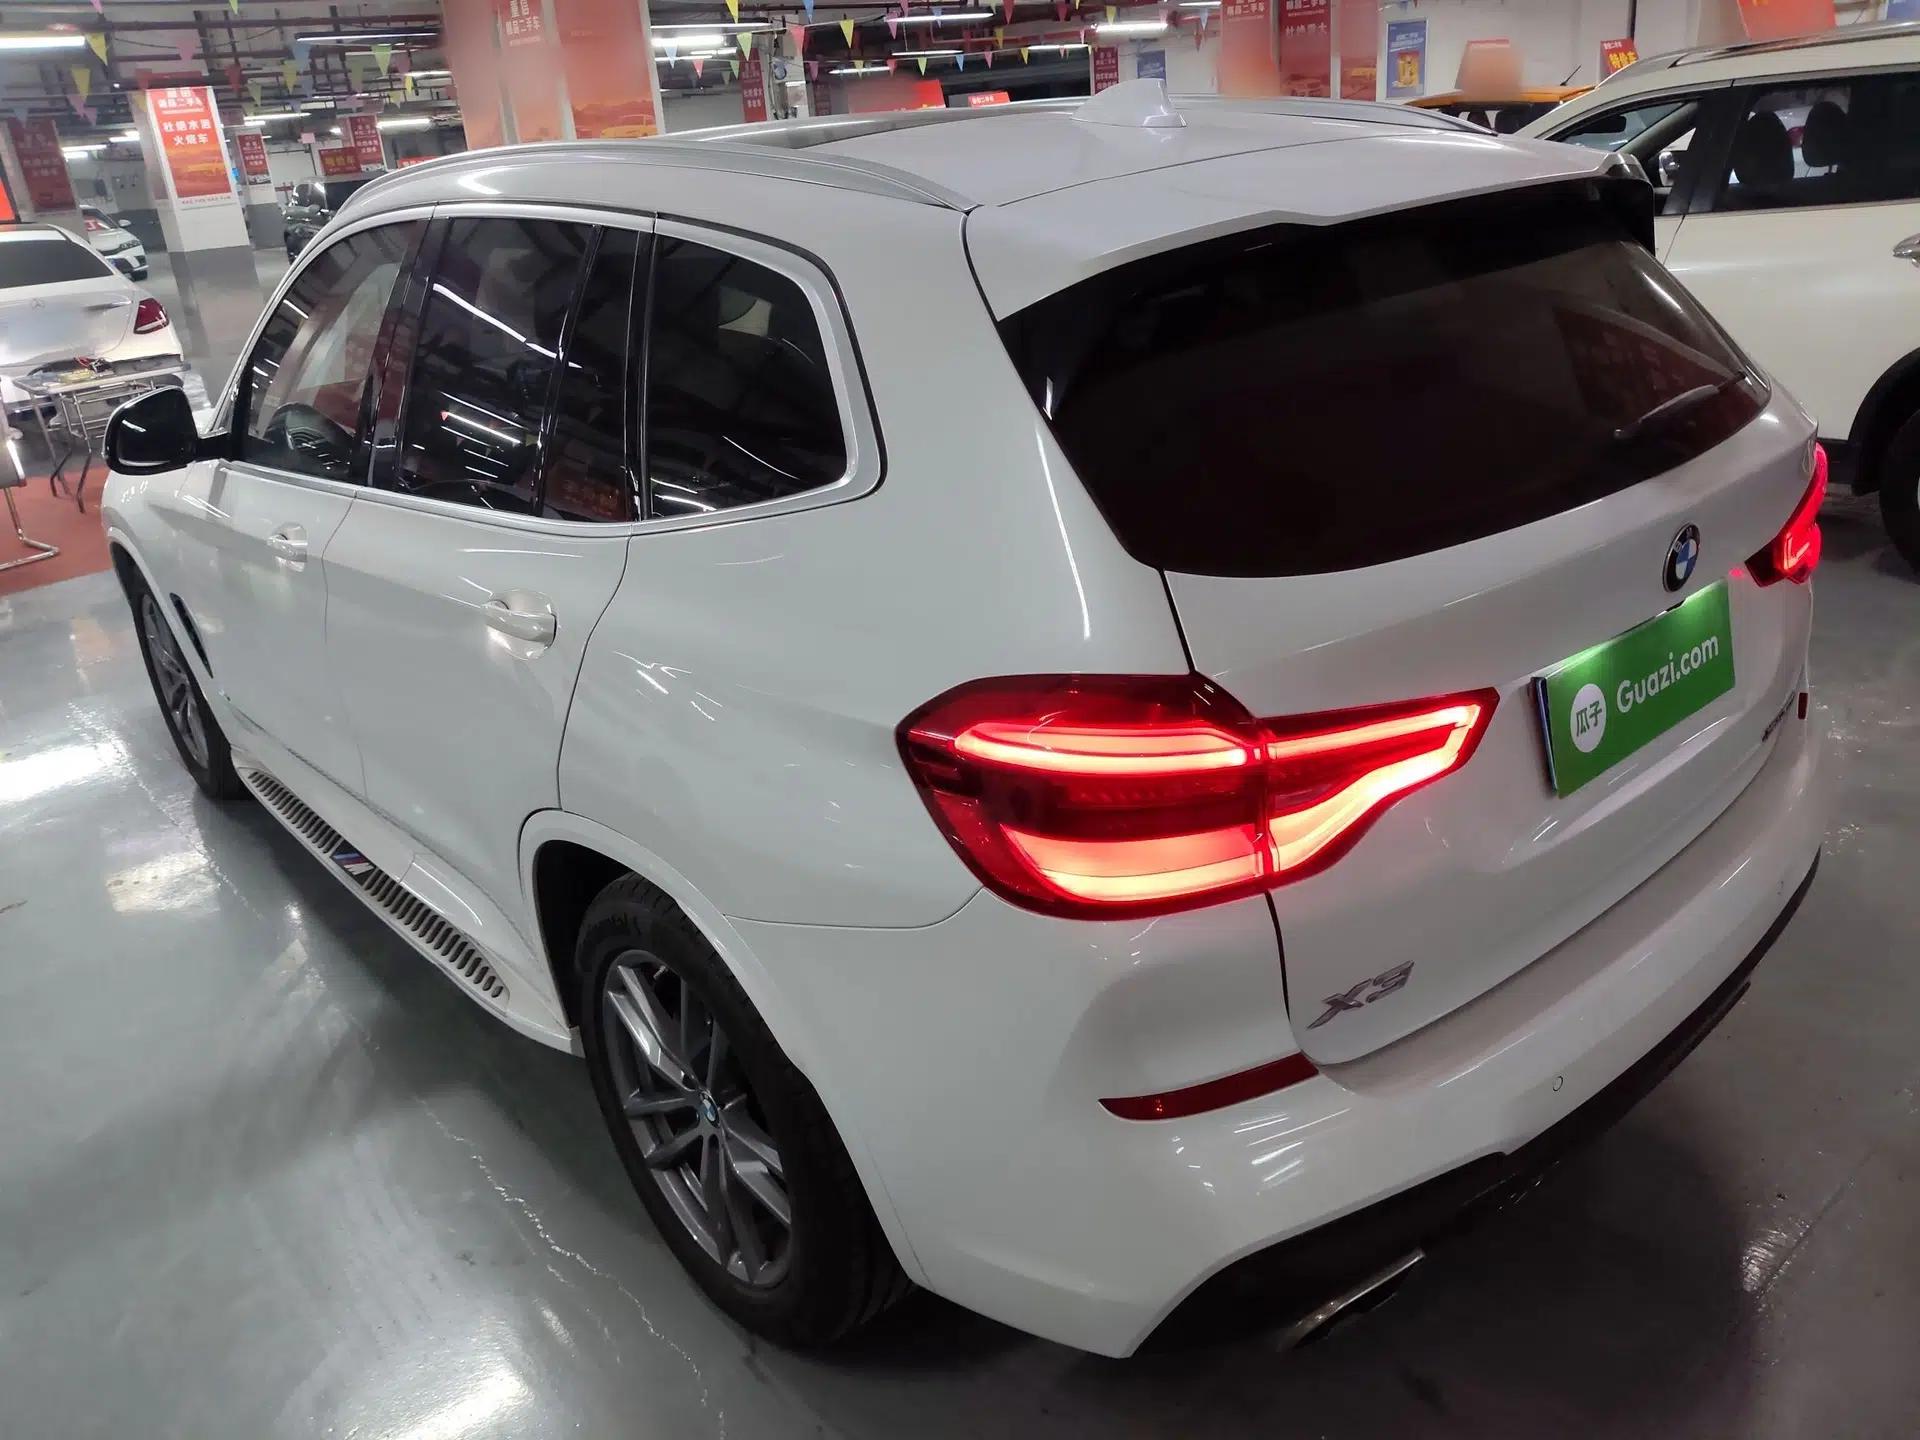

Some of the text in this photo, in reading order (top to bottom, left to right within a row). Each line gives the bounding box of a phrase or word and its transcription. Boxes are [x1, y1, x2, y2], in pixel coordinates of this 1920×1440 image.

[1616, 635, 1719, 713] Guazi.com
[1576, 700, 1603, 737] 瓜子
[1306, 960, 1415, 1030] X3
